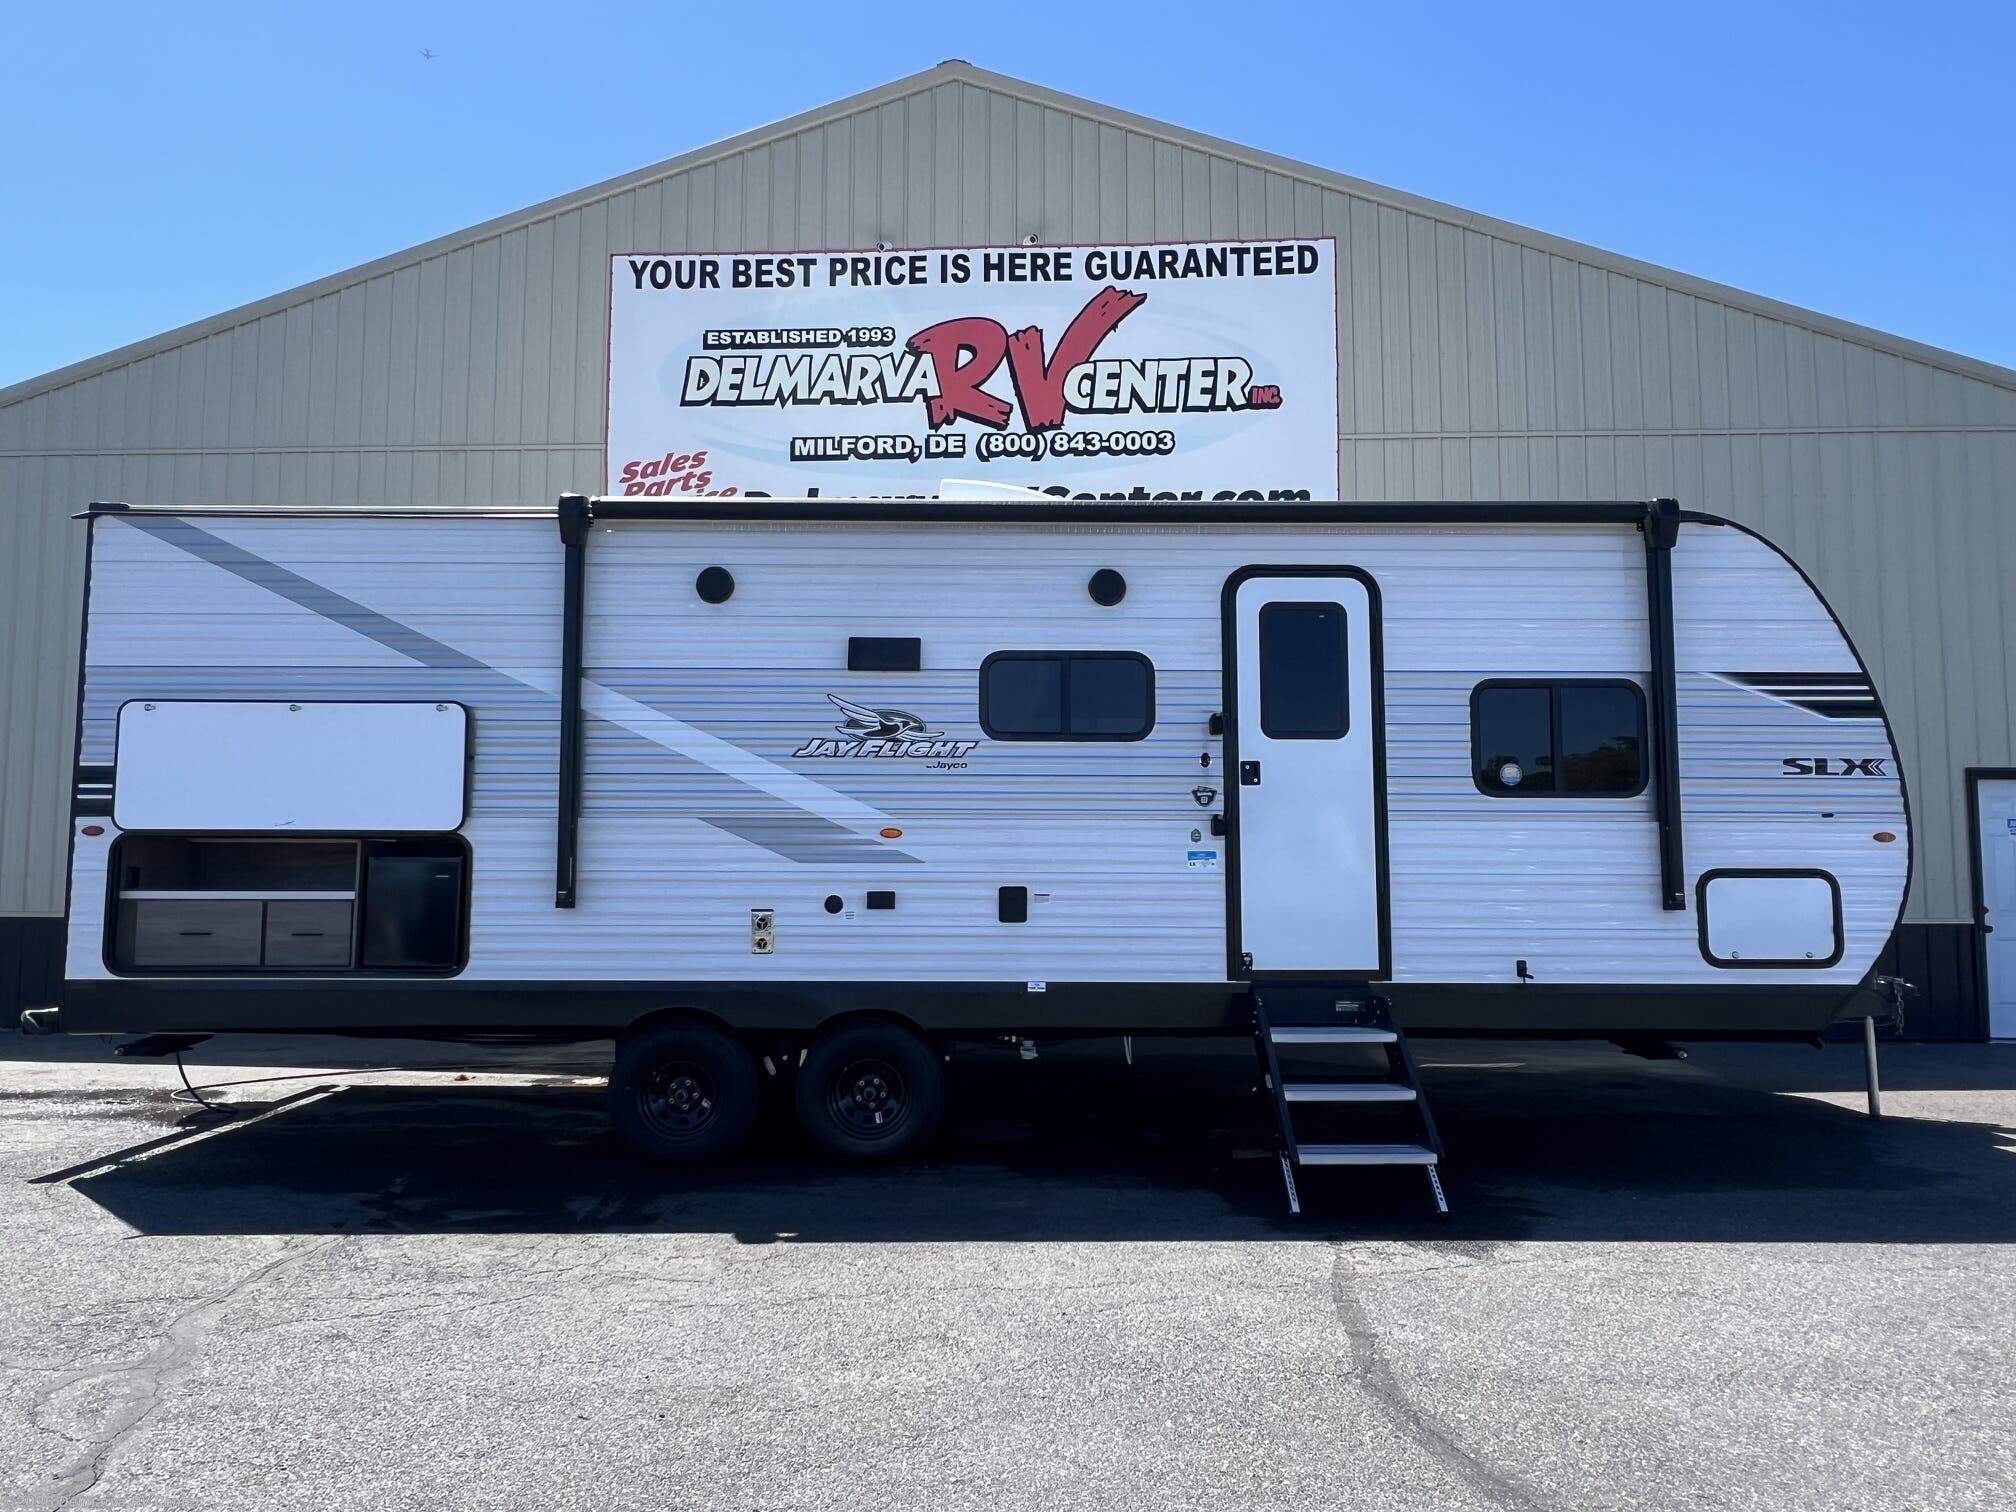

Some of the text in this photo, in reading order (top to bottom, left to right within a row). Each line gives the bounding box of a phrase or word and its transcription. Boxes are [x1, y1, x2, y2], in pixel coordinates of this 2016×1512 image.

[629, 245, 1319, 290] YOUR BEST PRICE IS HERE GUARANTEED
[704, 328, 895, 348] ESTABLISHED 1993
[681, 353, 942, 408] DELMARVA
[906, 285, 1147, 432] RV
[1063, 357, 1254, 413] CENTER
[790, 431, 1175, 462] MILFORD, DE (800) 843-0003
[619, 450, 708, 484] Sales
